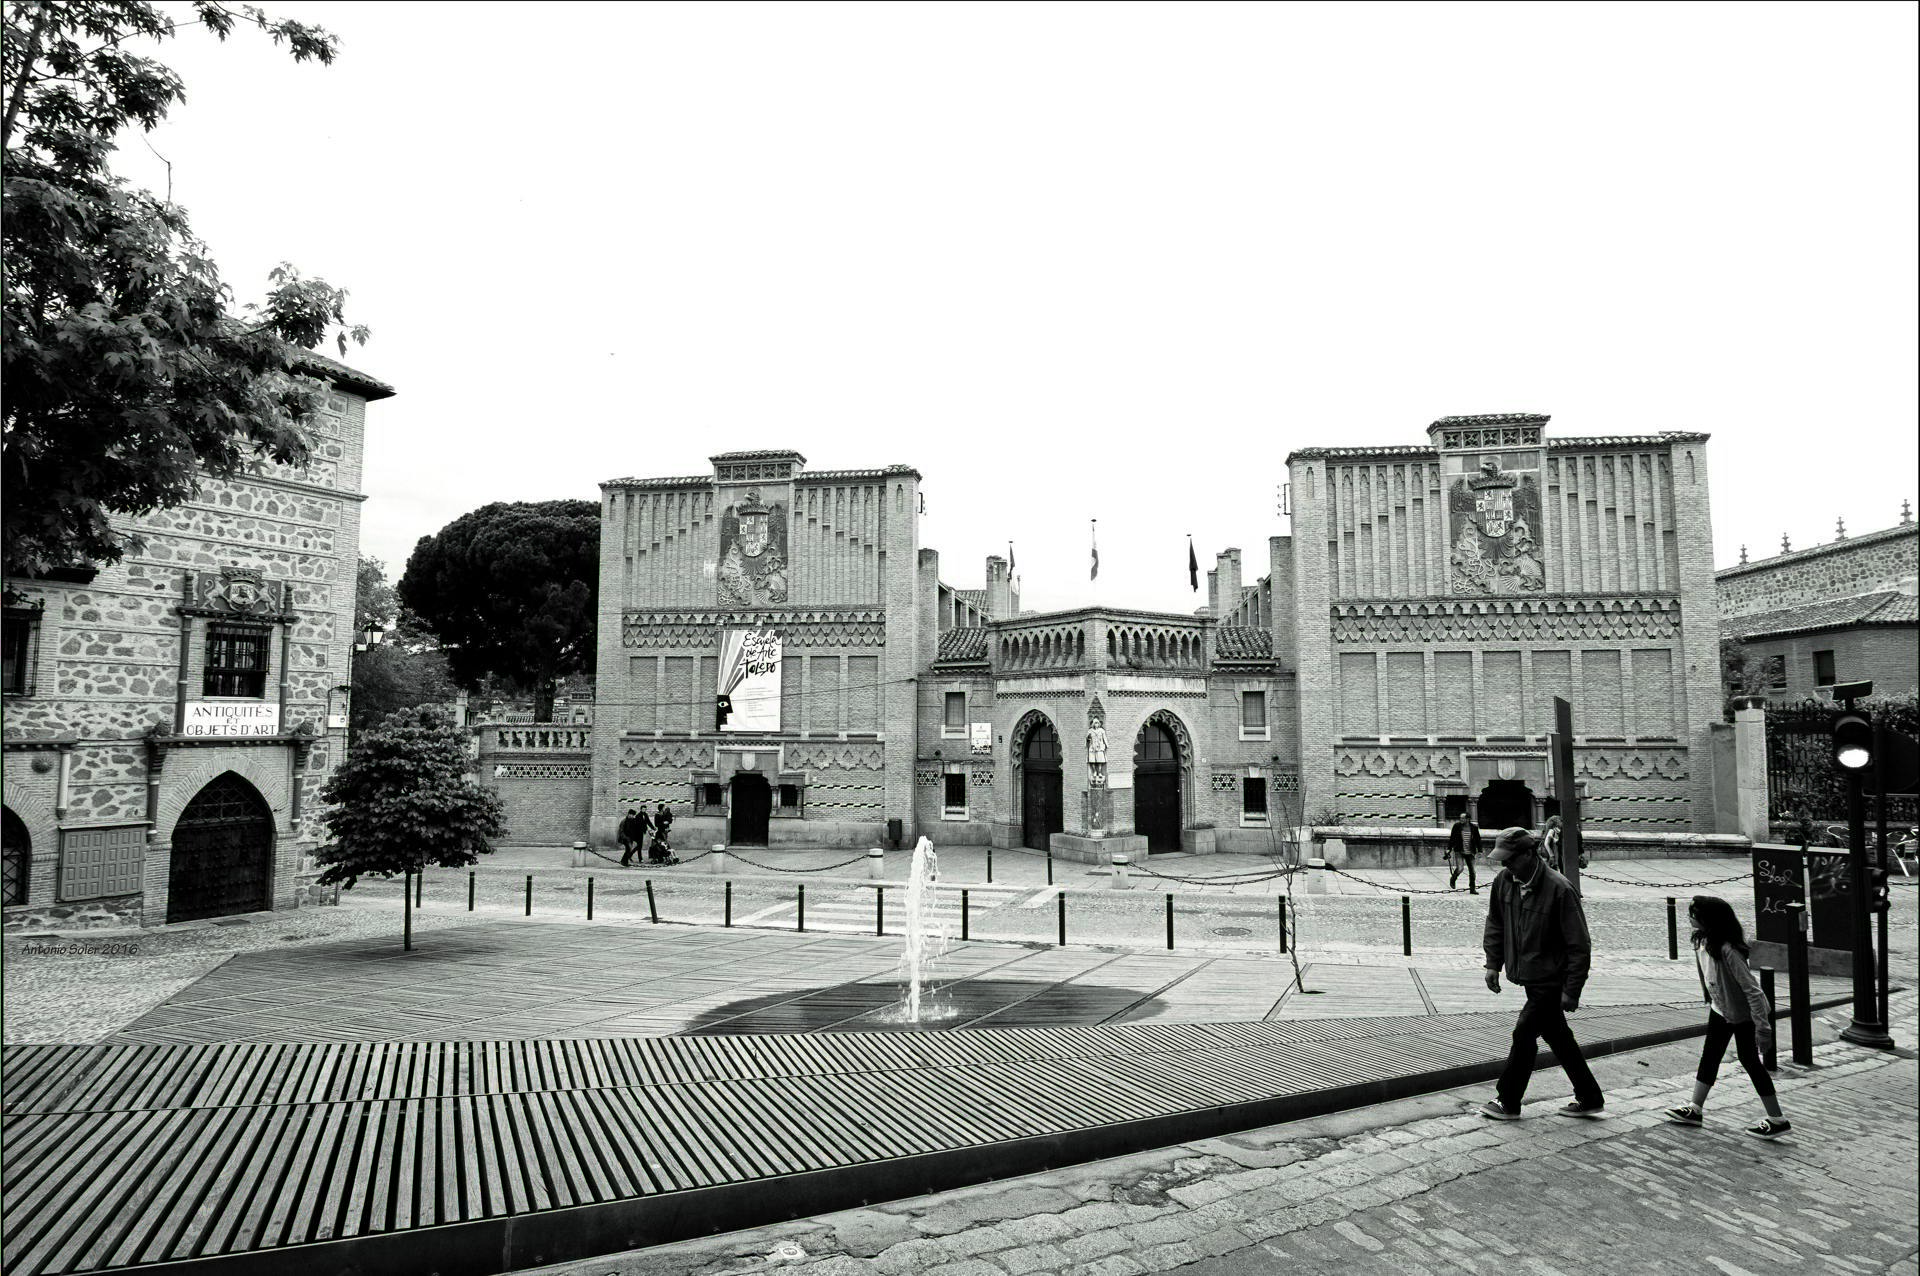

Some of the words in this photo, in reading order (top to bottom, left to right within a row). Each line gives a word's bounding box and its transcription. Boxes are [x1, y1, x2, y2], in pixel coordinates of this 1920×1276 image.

[743, 631, 781, 648] Escuela
[746, 648, 757, 657] de
[757, 645, 777, 661] Arte
[192, 705, 273, 718] ANTIQUITÉS
[186, 725, 238, 735] OBJETS
[240, 725, 277, 735] D'ART
